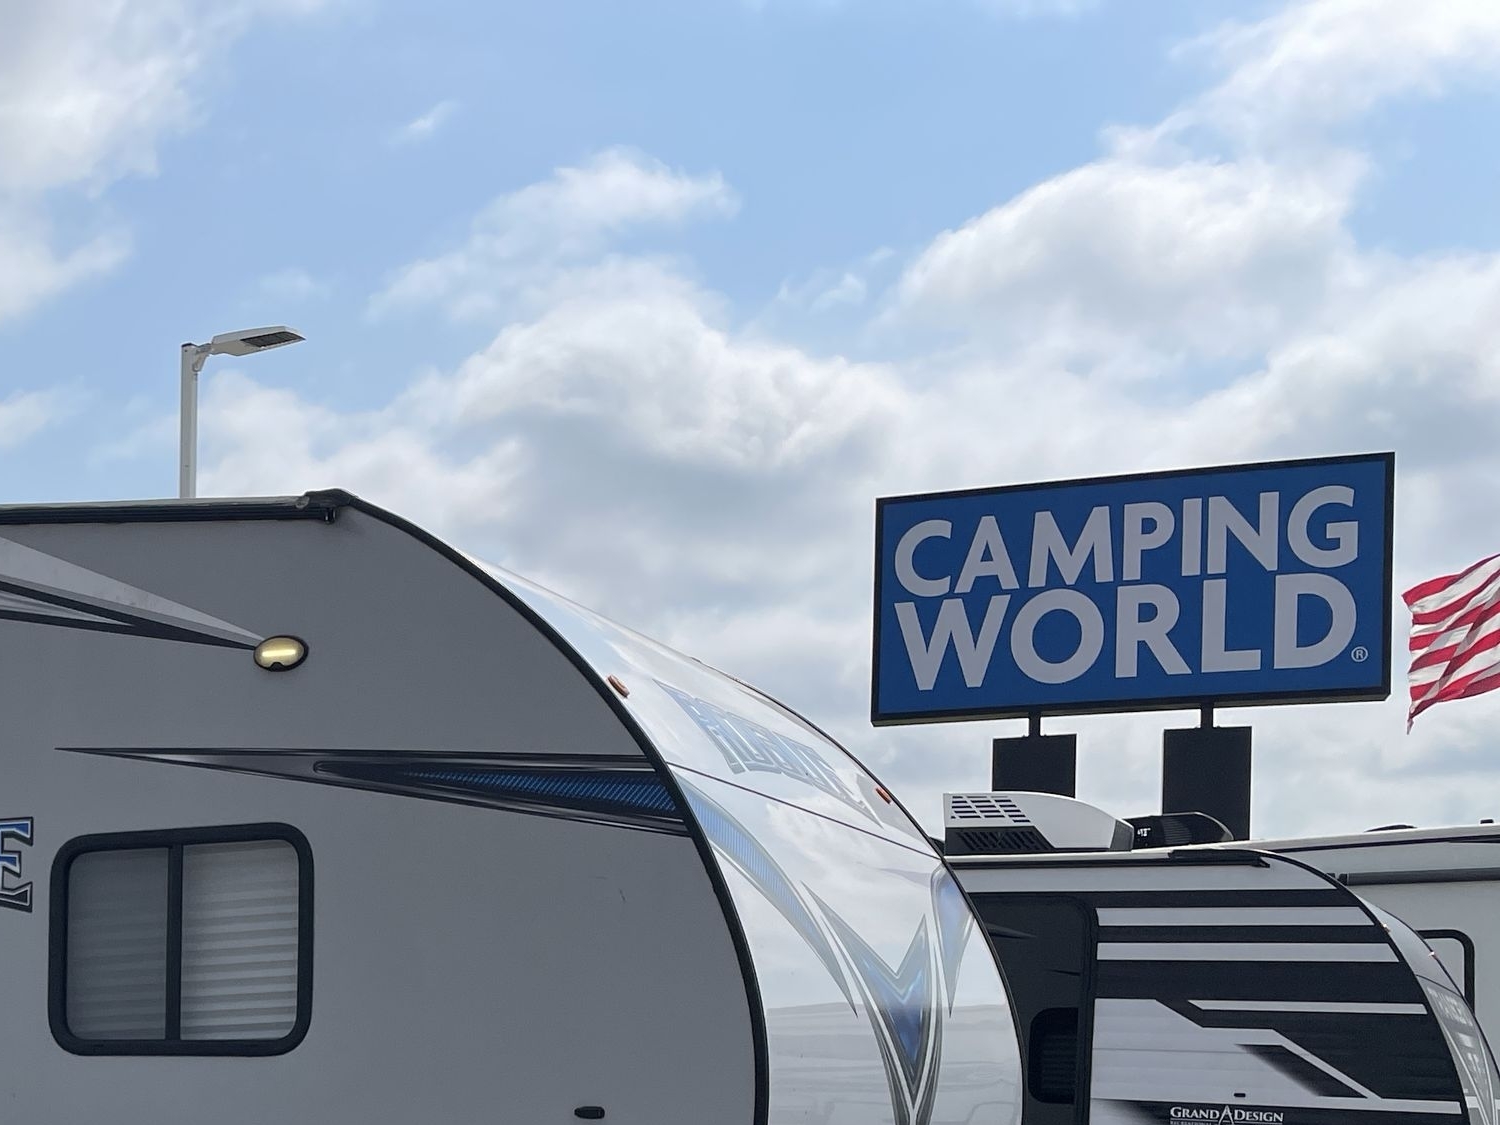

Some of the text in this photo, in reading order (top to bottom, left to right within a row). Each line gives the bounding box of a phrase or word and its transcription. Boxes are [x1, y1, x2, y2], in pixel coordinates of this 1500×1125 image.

[894, 485, 1359, 597] CAMPING
[894, 573, 1357, 691] WORLD
[1170, 1106, 1284, 1122] GRAND DESIGN
